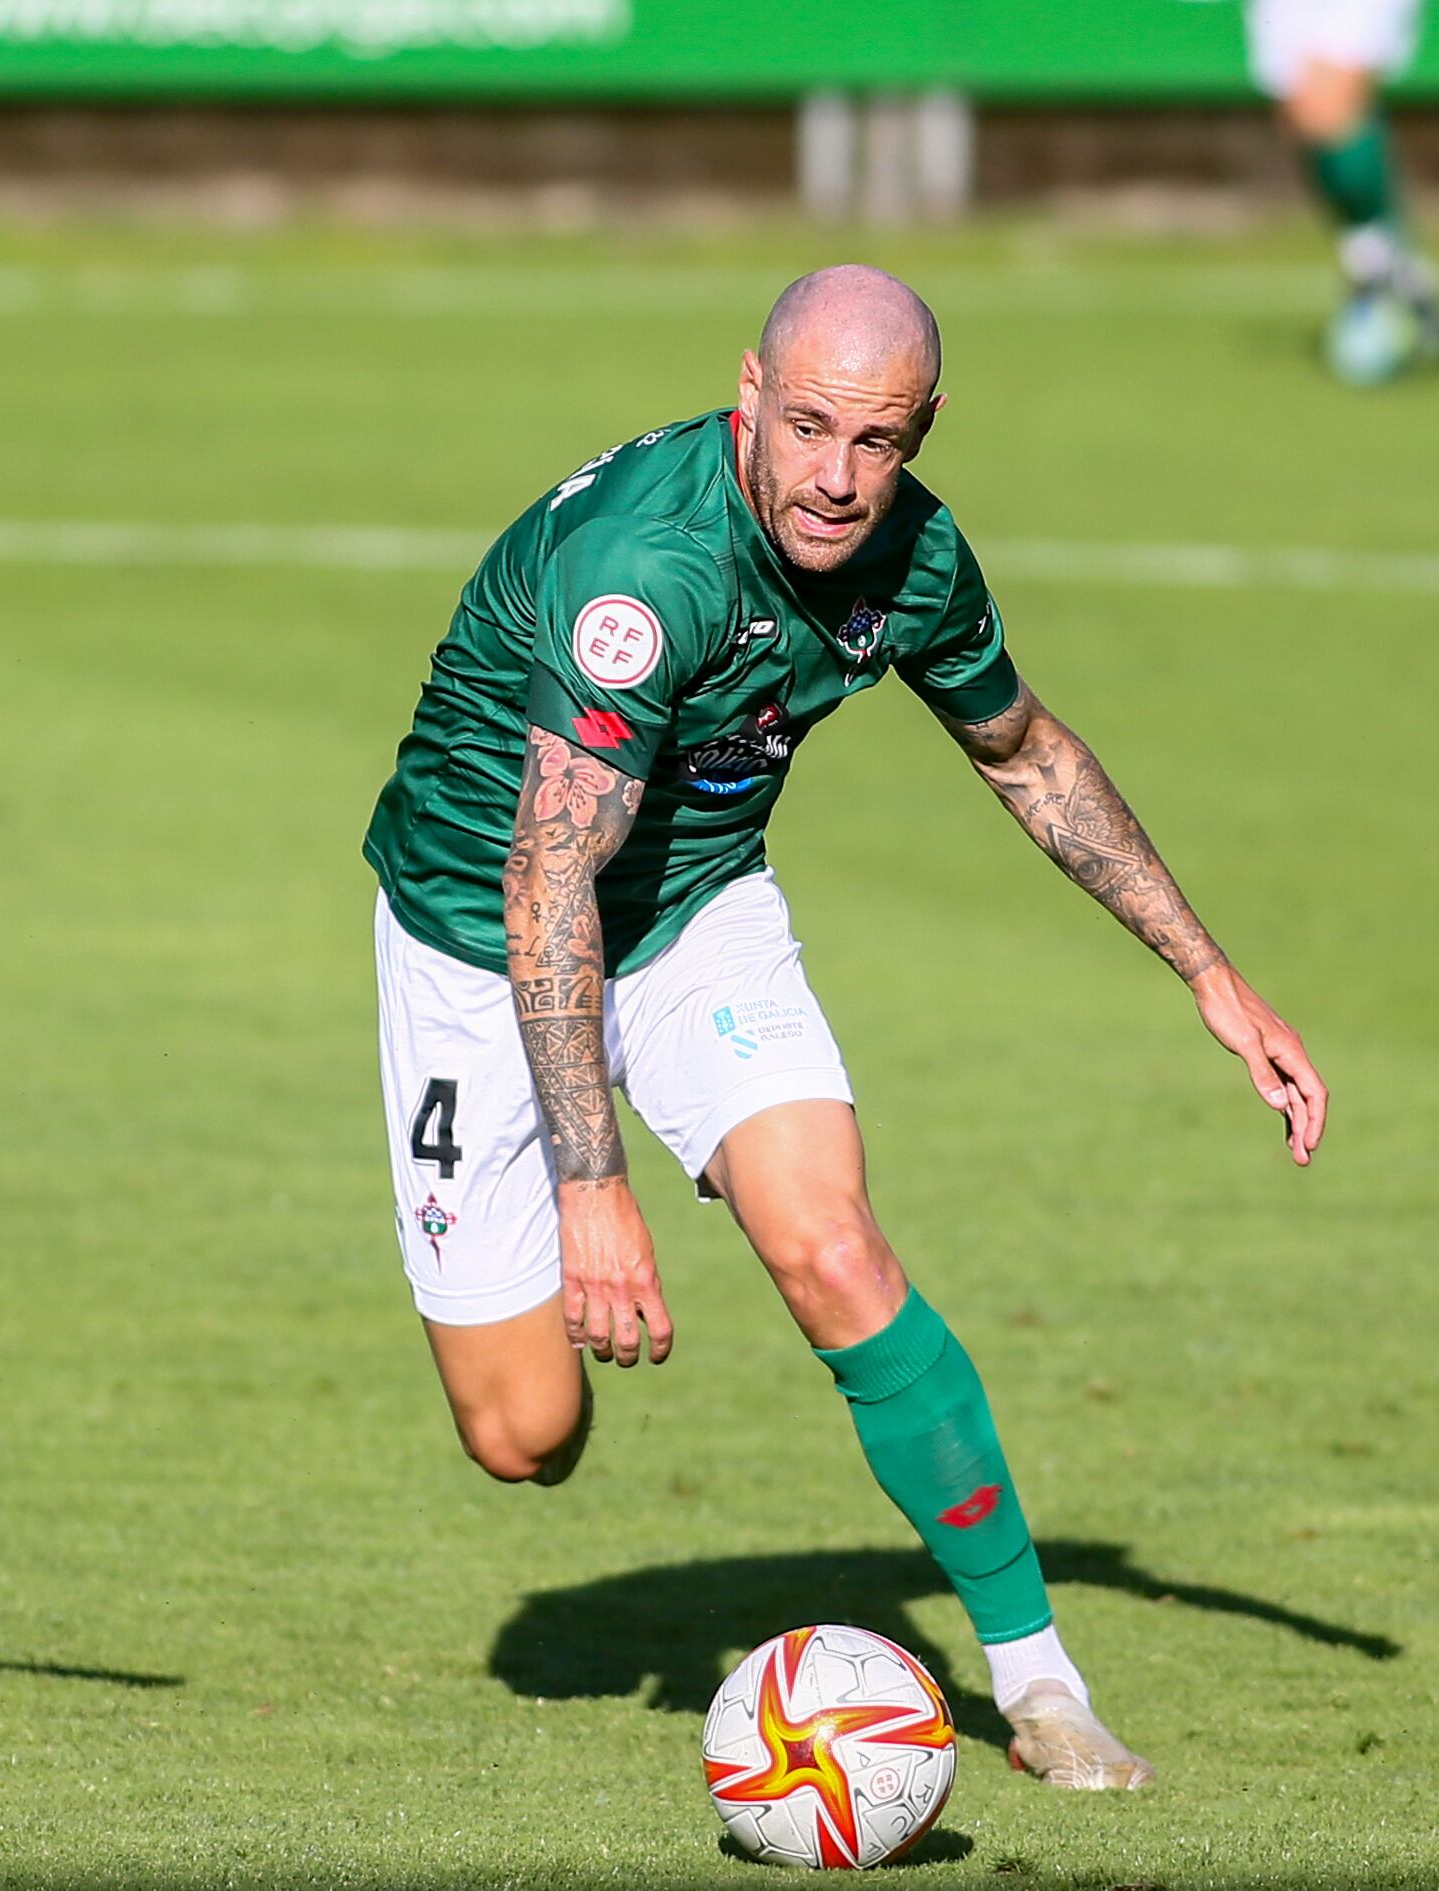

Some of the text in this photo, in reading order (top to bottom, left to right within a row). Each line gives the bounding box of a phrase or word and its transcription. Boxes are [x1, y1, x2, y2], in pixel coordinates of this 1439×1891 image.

[735, 999, 779, 1014] XUNTA
[737, 1007, 808, 1025] DE GALICIA
[411, 1077, 463, 1179] 4
